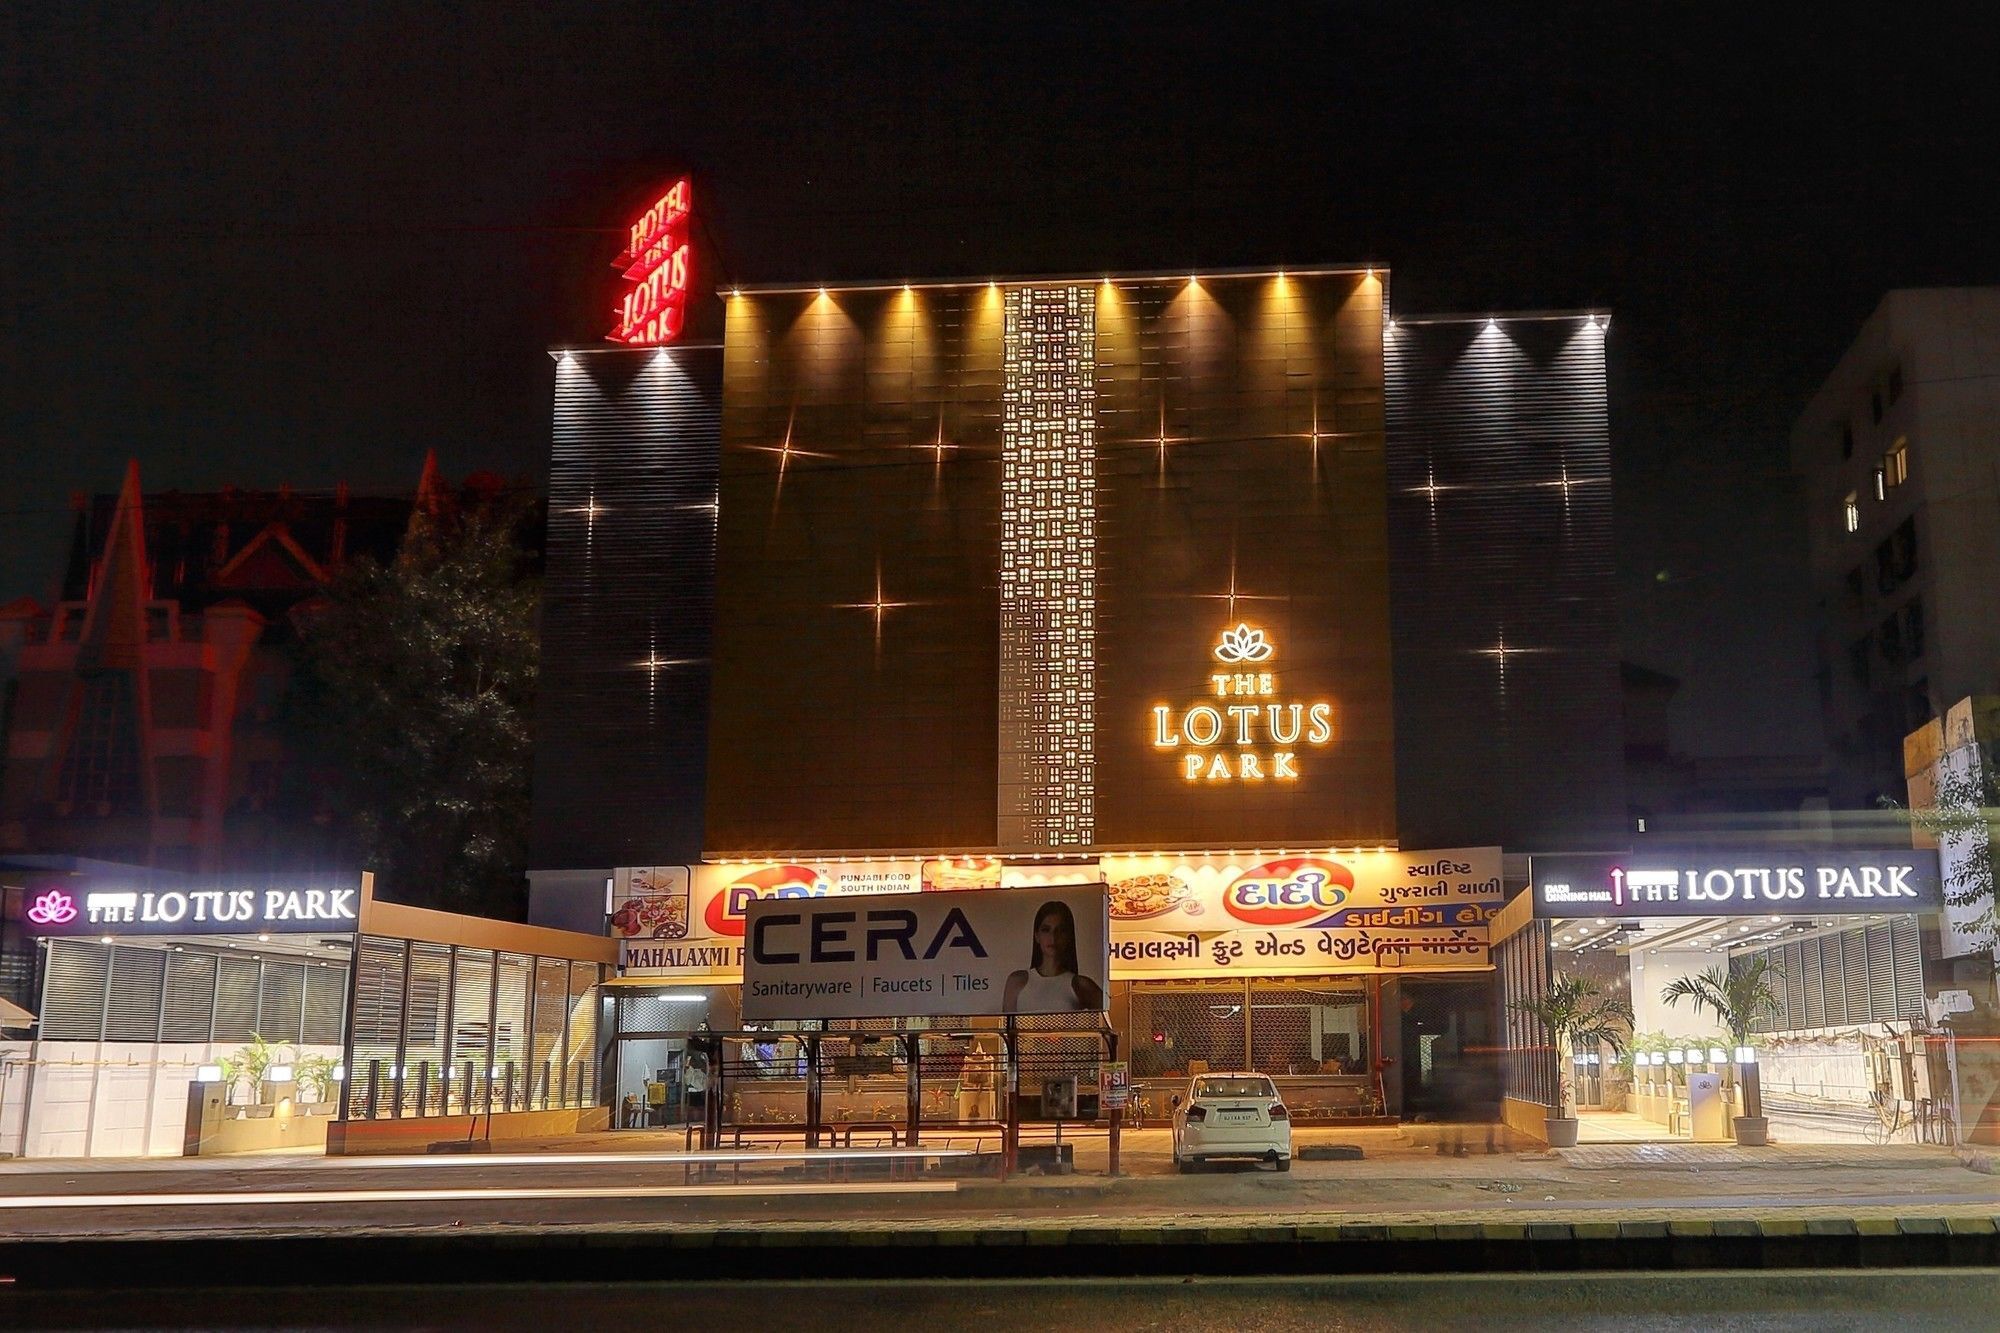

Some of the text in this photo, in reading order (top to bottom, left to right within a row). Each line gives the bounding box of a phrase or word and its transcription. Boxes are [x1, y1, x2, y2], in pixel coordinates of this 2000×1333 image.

[630, 181, 688, 259] HOTEL
[621, 245, 689, 337] LOTUS
[1212, 673, 1273, 696] THE
[1153, 703, 1331, 747] LOTUS
[1184, 752, 1299, 780] PARK
[885, 873, 911, 881] FOOD
[1407, 859, 1472, 877] સ્વાદિષ્ટ
[840, 883, 910, 893] SOUTH INDIAN
[1235, 873, 1346, 906] દાદી
[1379, 877, 1500, 904] ગુજરાતી થાળી
[1588, 891, 1613, 902] HALL
[1628, 866, 1918, 902] THE LOTUS PARK
[87, 889, 357, 923] THE LOTUS PARK
[752, 907, 989, 965] CERA
[1254, 932, 1306, 956] એન્ડ
[626, 947, 729, 968] MAHALAXMI
[752, 975, 989, 999] Sanitaryware Faucets Tiles
[1103, 1072, 1125, 1086] PSI
